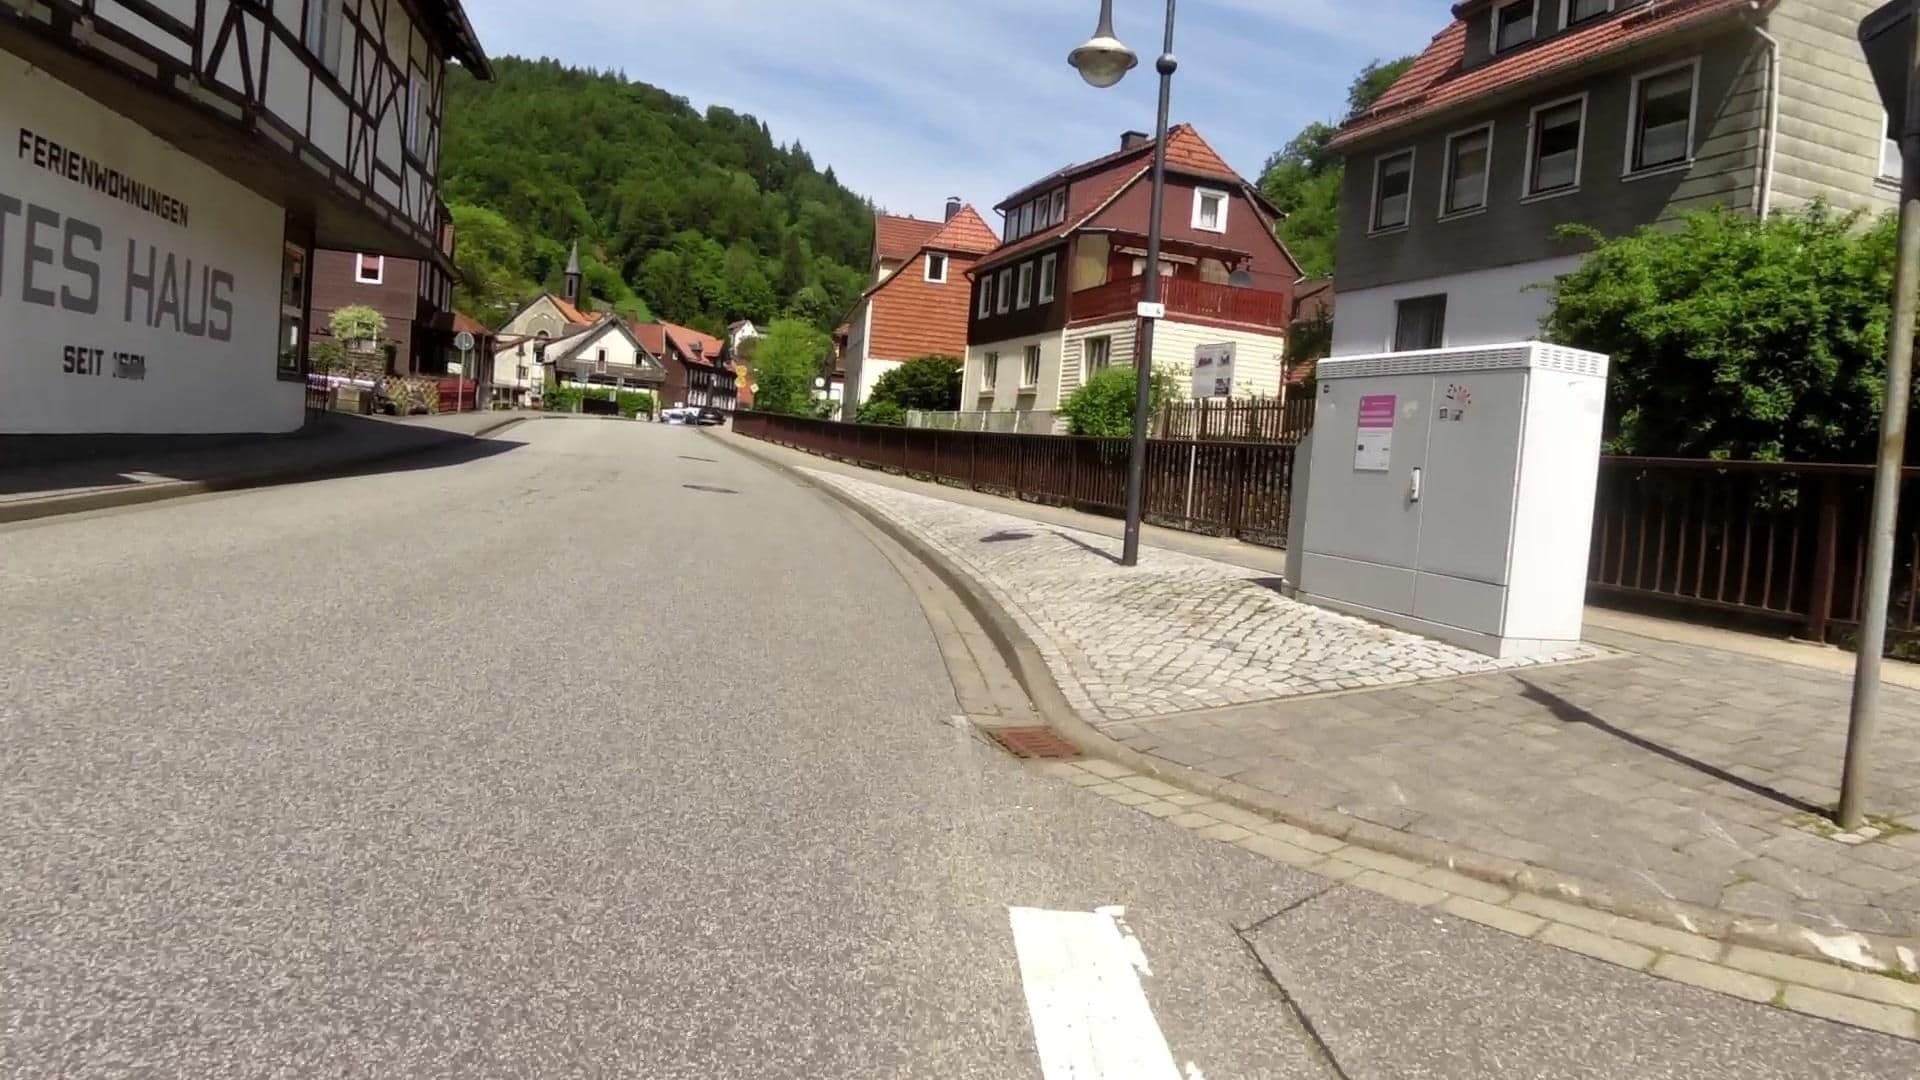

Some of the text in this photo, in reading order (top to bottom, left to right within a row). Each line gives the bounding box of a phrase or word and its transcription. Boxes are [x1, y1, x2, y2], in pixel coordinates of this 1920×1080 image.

[19, 128, 189, 227] FERIENWOHNUNGEN
[124, 238, 233, 341] HAUS
[63, 345, 104, 377] SEIT
